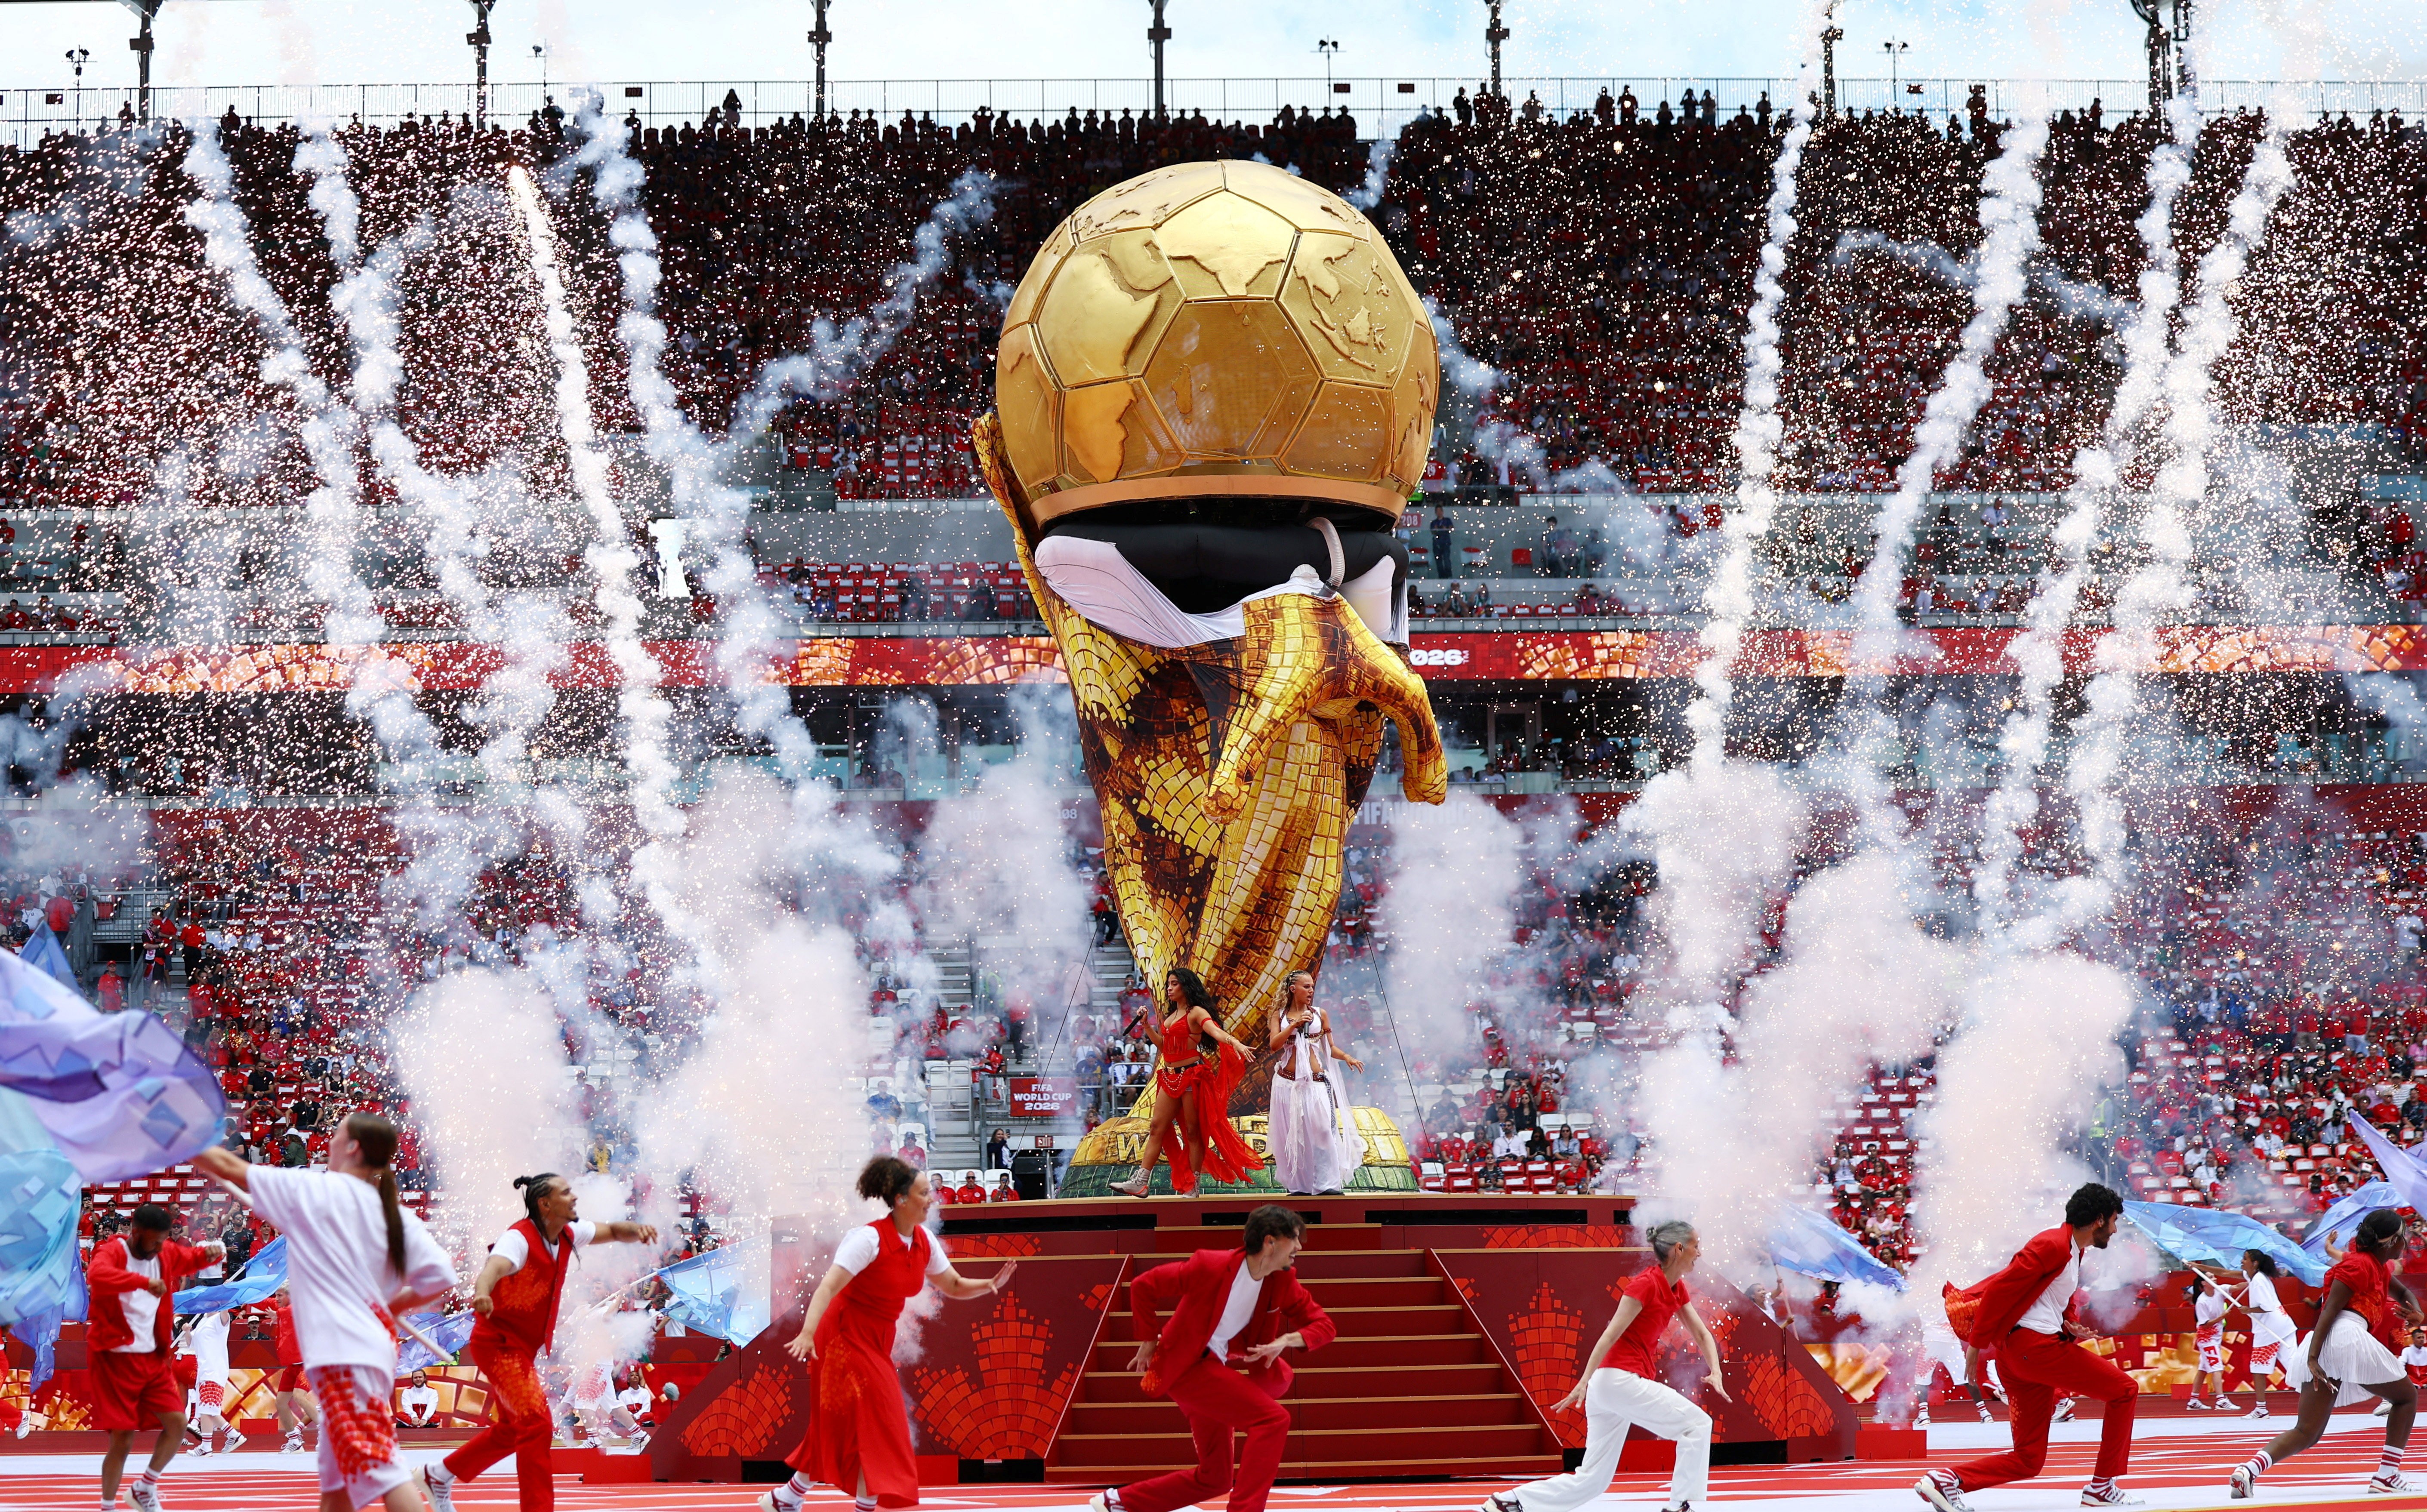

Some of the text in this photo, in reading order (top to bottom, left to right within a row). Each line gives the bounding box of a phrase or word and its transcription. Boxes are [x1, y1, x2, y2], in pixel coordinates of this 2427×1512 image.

[1427, 465, 1436, 476] 19
[1401, 515, 1418, 526] 208
[1057, 809, 1077, 819] 108
[1013, 1093, 1050, 1101] WORLD
[1024, 1102, 1061, 1110] 2026
[1038, 1137, 1051, 1147] EXIT
